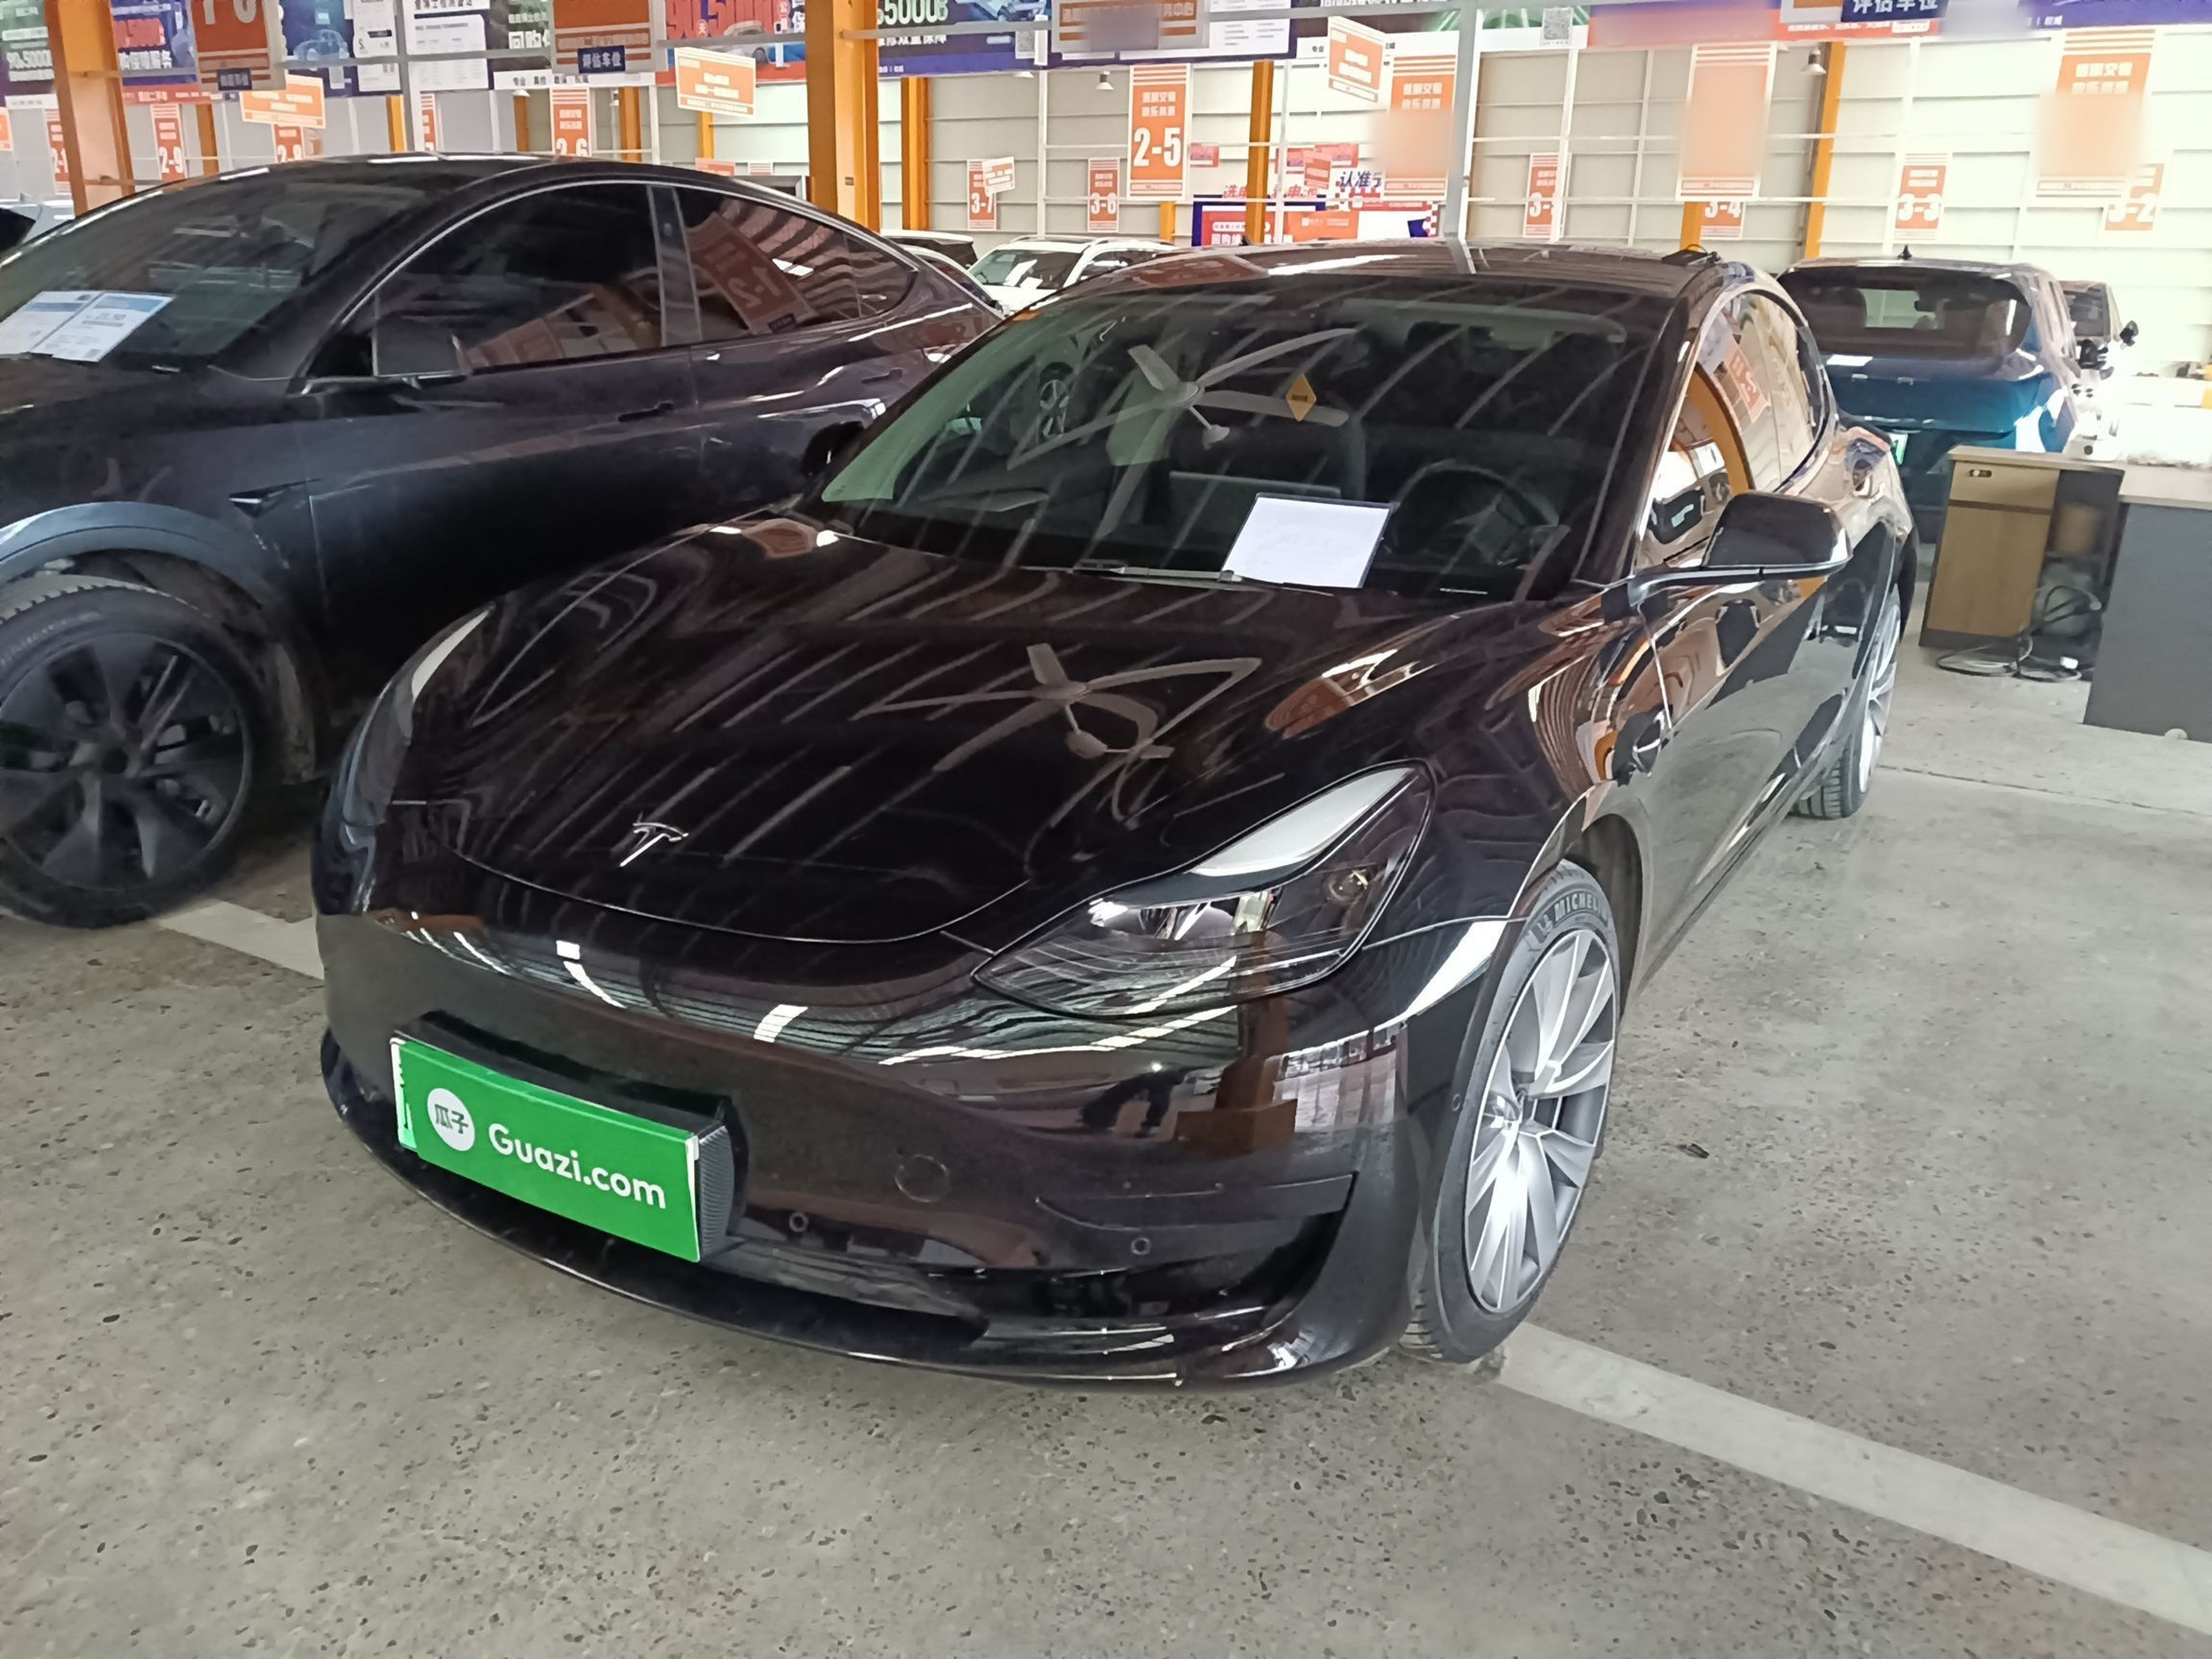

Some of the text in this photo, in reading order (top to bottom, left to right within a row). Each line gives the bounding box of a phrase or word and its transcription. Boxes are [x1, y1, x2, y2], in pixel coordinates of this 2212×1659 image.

[159, 146, 184, 173] 2-9
[1133, 127, 1181, 167] 2-5
[971, 192, 994, 214] 3-7
[1899, 193, 1941, 221] 3-3
[434, 1104, 469, 1134] 瓜子
[488, 1123, 666, 1209] Guazi.com
